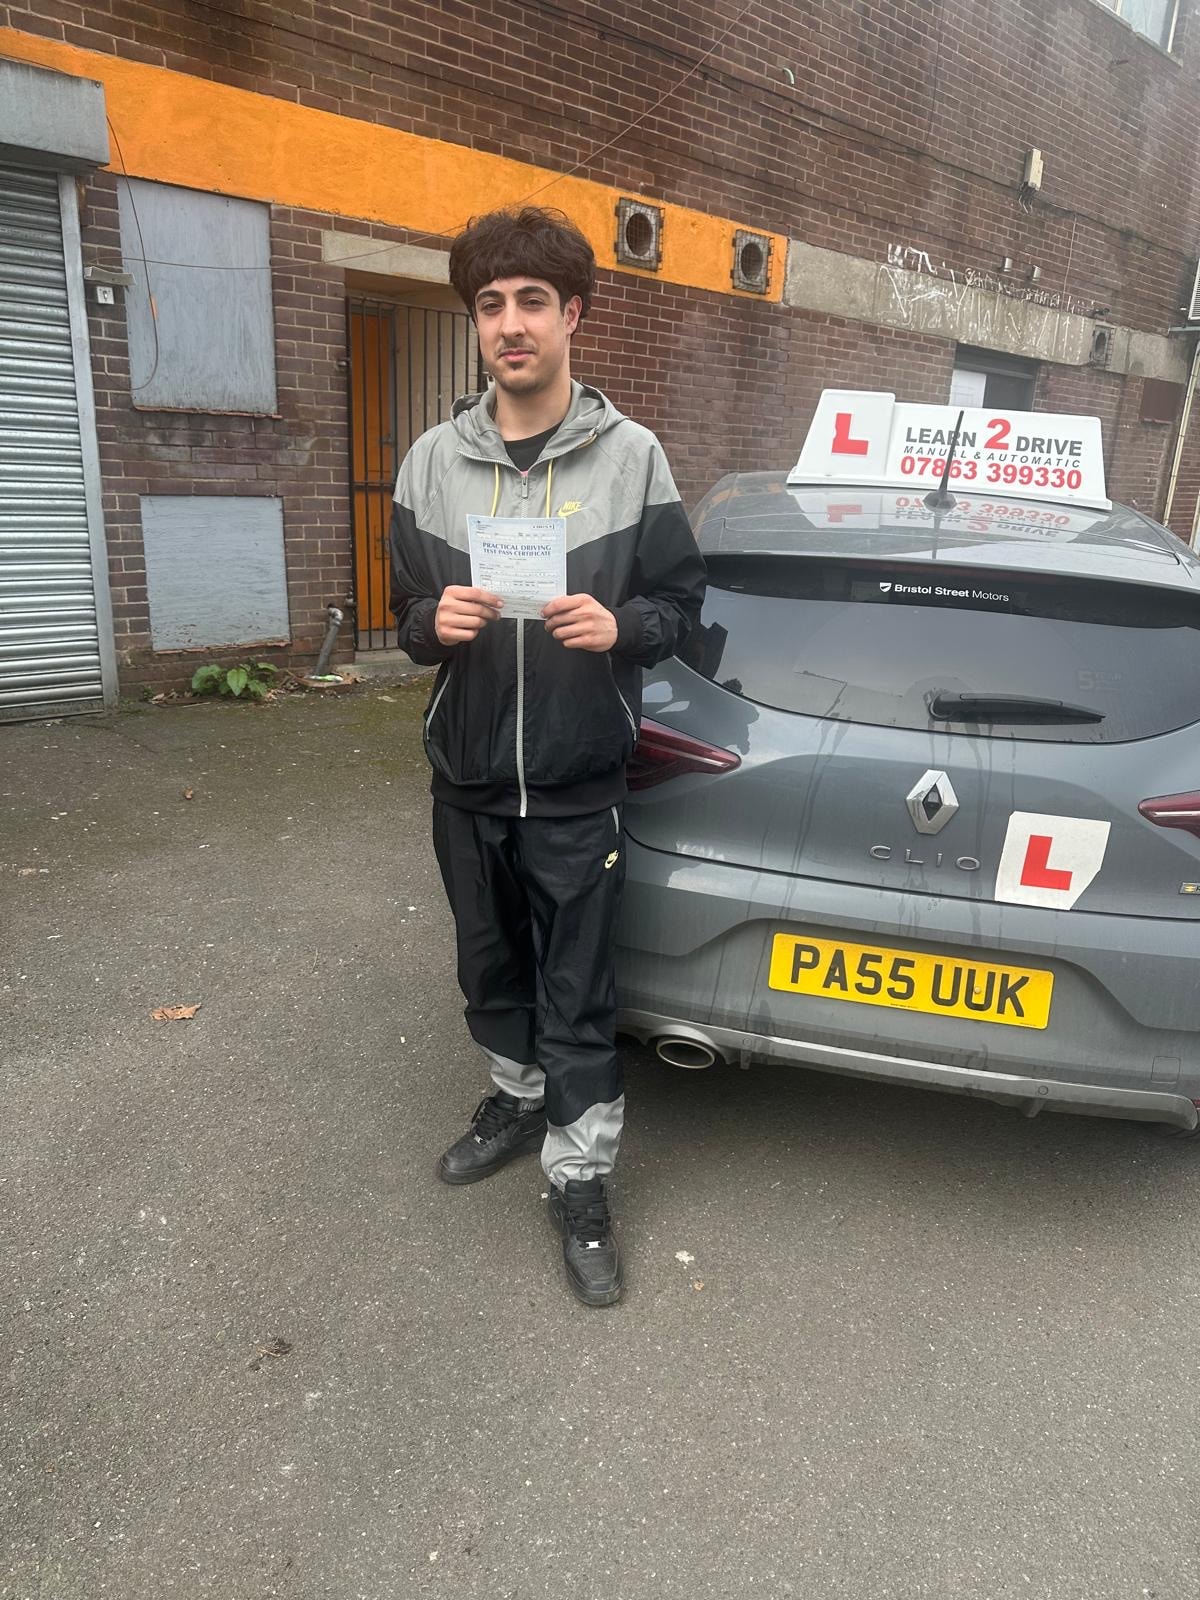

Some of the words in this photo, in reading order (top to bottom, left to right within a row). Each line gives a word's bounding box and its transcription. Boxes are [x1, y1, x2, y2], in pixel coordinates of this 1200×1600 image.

[831, 412, 869, 456] L
[905, 426, 977, 448] LEARN
[983, 417, 1012, 451] 2
[1015, 435, 1083, 457] DRIVE
[900, 455, 978, 480] 07863
[985, 462, 1083, 490] 399330
[973, 451, 982, 460] &
[986, 452, 1081, 468] AUTOMATIC
[482, 541, 519, 551] PRACTICAL
[520, 544, 552, 552] DRIVING
[483, 547, 497, 555] TEST
[894, 584, 932, 595] Bristol
[934, 586, 970, 598] Street
[972, 590, 1010, 602] Motors
[869, 845, 981, 871] CLIO
[1019, 834, 1073, 891] L
[931, 963, 1031, 1018] UUK
